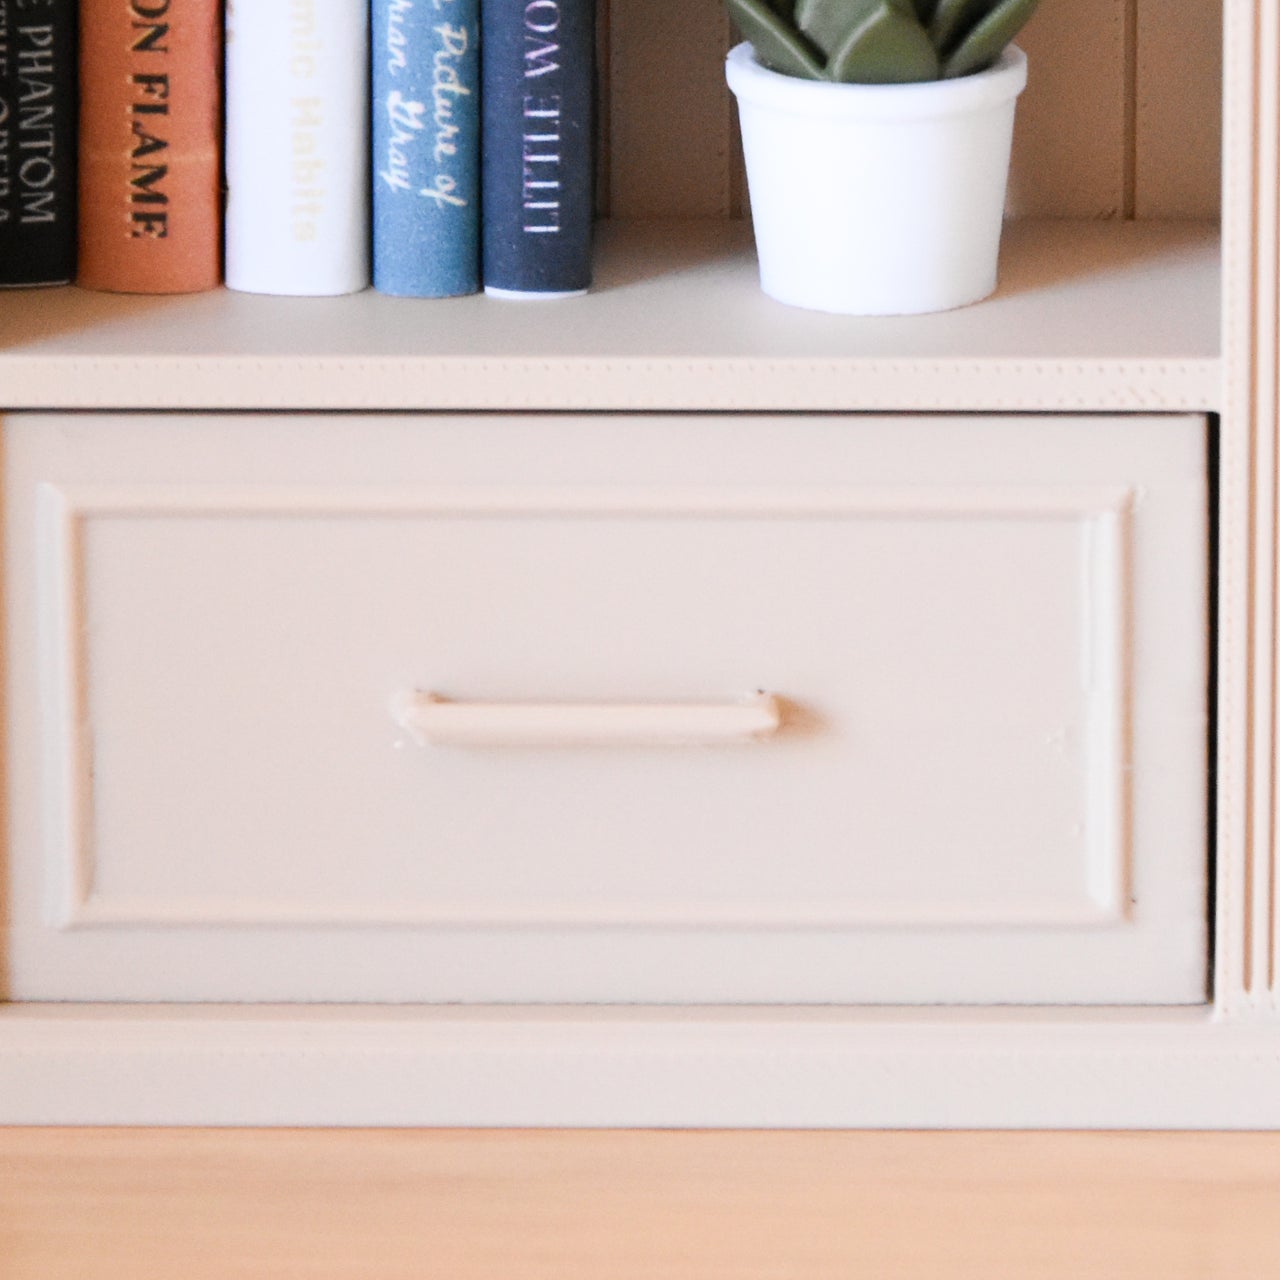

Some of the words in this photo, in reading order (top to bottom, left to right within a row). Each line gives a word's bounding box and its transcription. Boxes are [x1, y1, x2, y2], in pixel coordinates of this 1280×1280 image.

[17, 23, 58, 225] PHANTOM
[127, 73, 169, 241] FLAME
[377, 86, 425, 193] Gray
[433, 21, 469, 161] Picture
[292, 94, 323, 243] Habits
[420, 170, 467, 209] of
[524, 94, 560, 235] LITTLE
